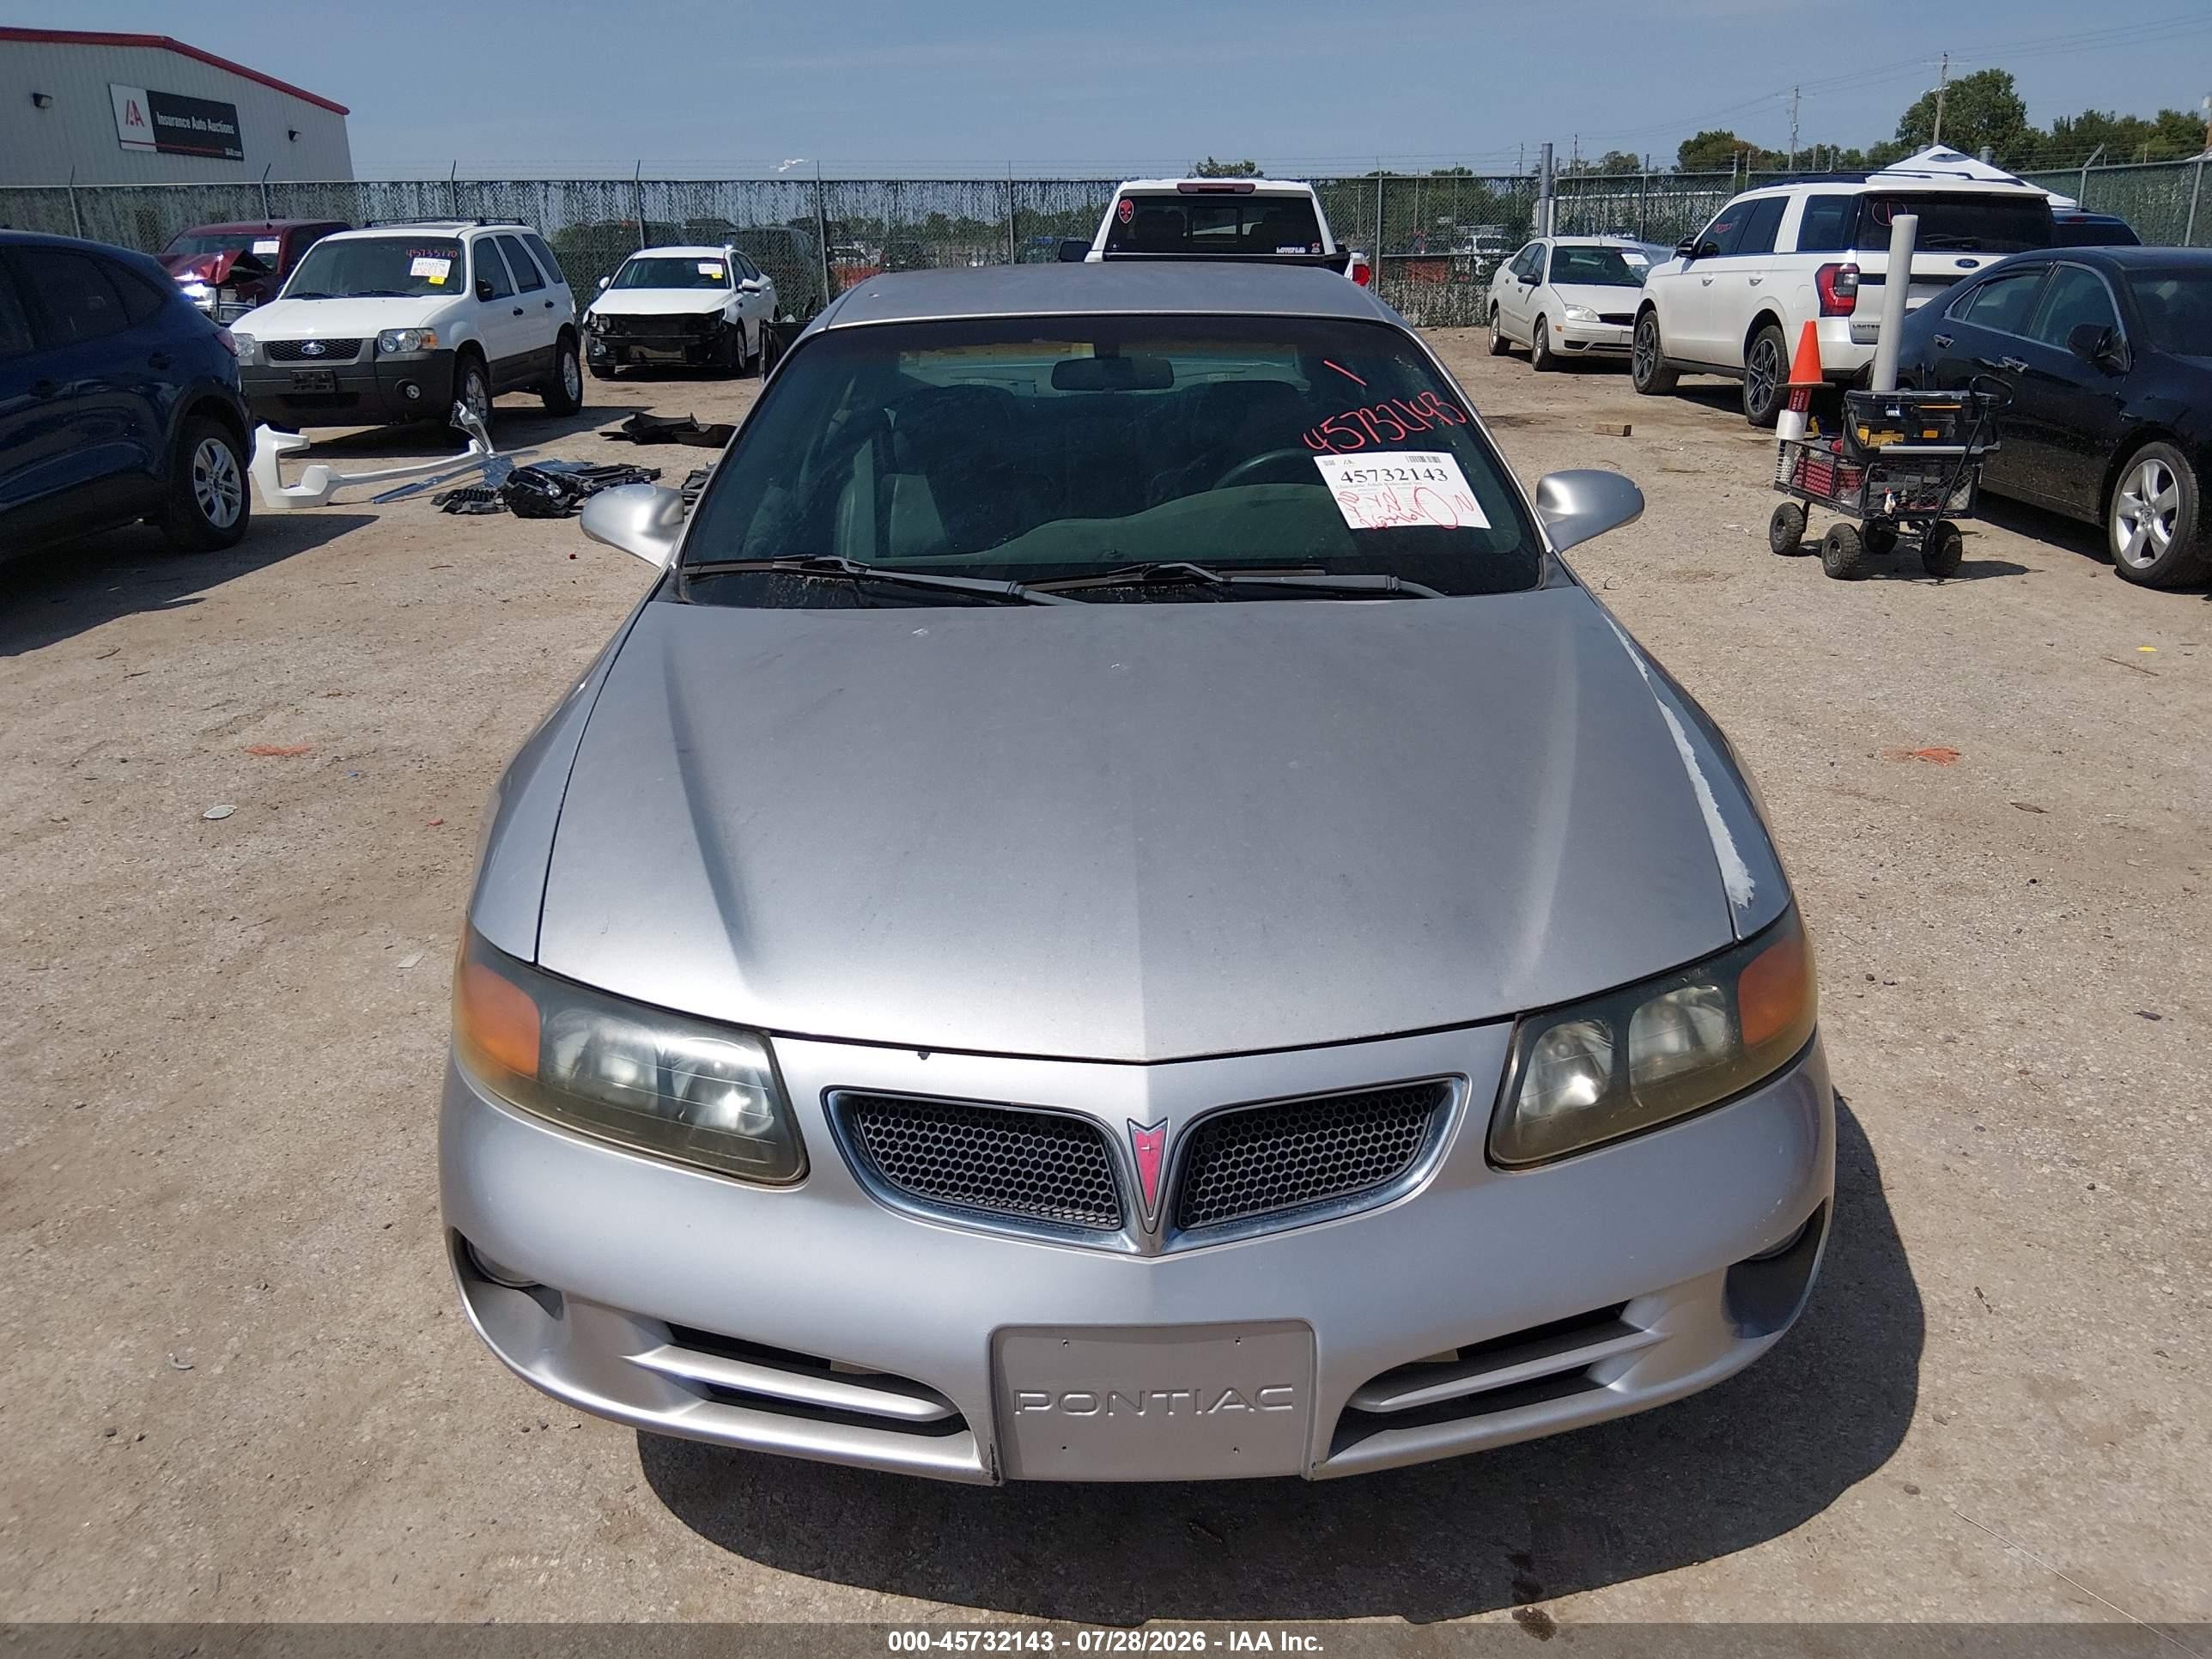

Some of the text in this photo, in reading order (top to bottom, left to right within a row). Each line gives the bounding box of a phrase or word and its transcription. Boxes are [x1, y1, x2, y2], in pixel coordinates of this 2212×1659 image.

[156, 111, 234, 135] Insurance Auto Auctions
[1340, 468, 1449, 483] 45732143
[1013, 1382, 1293, 1416] PONTIAC
